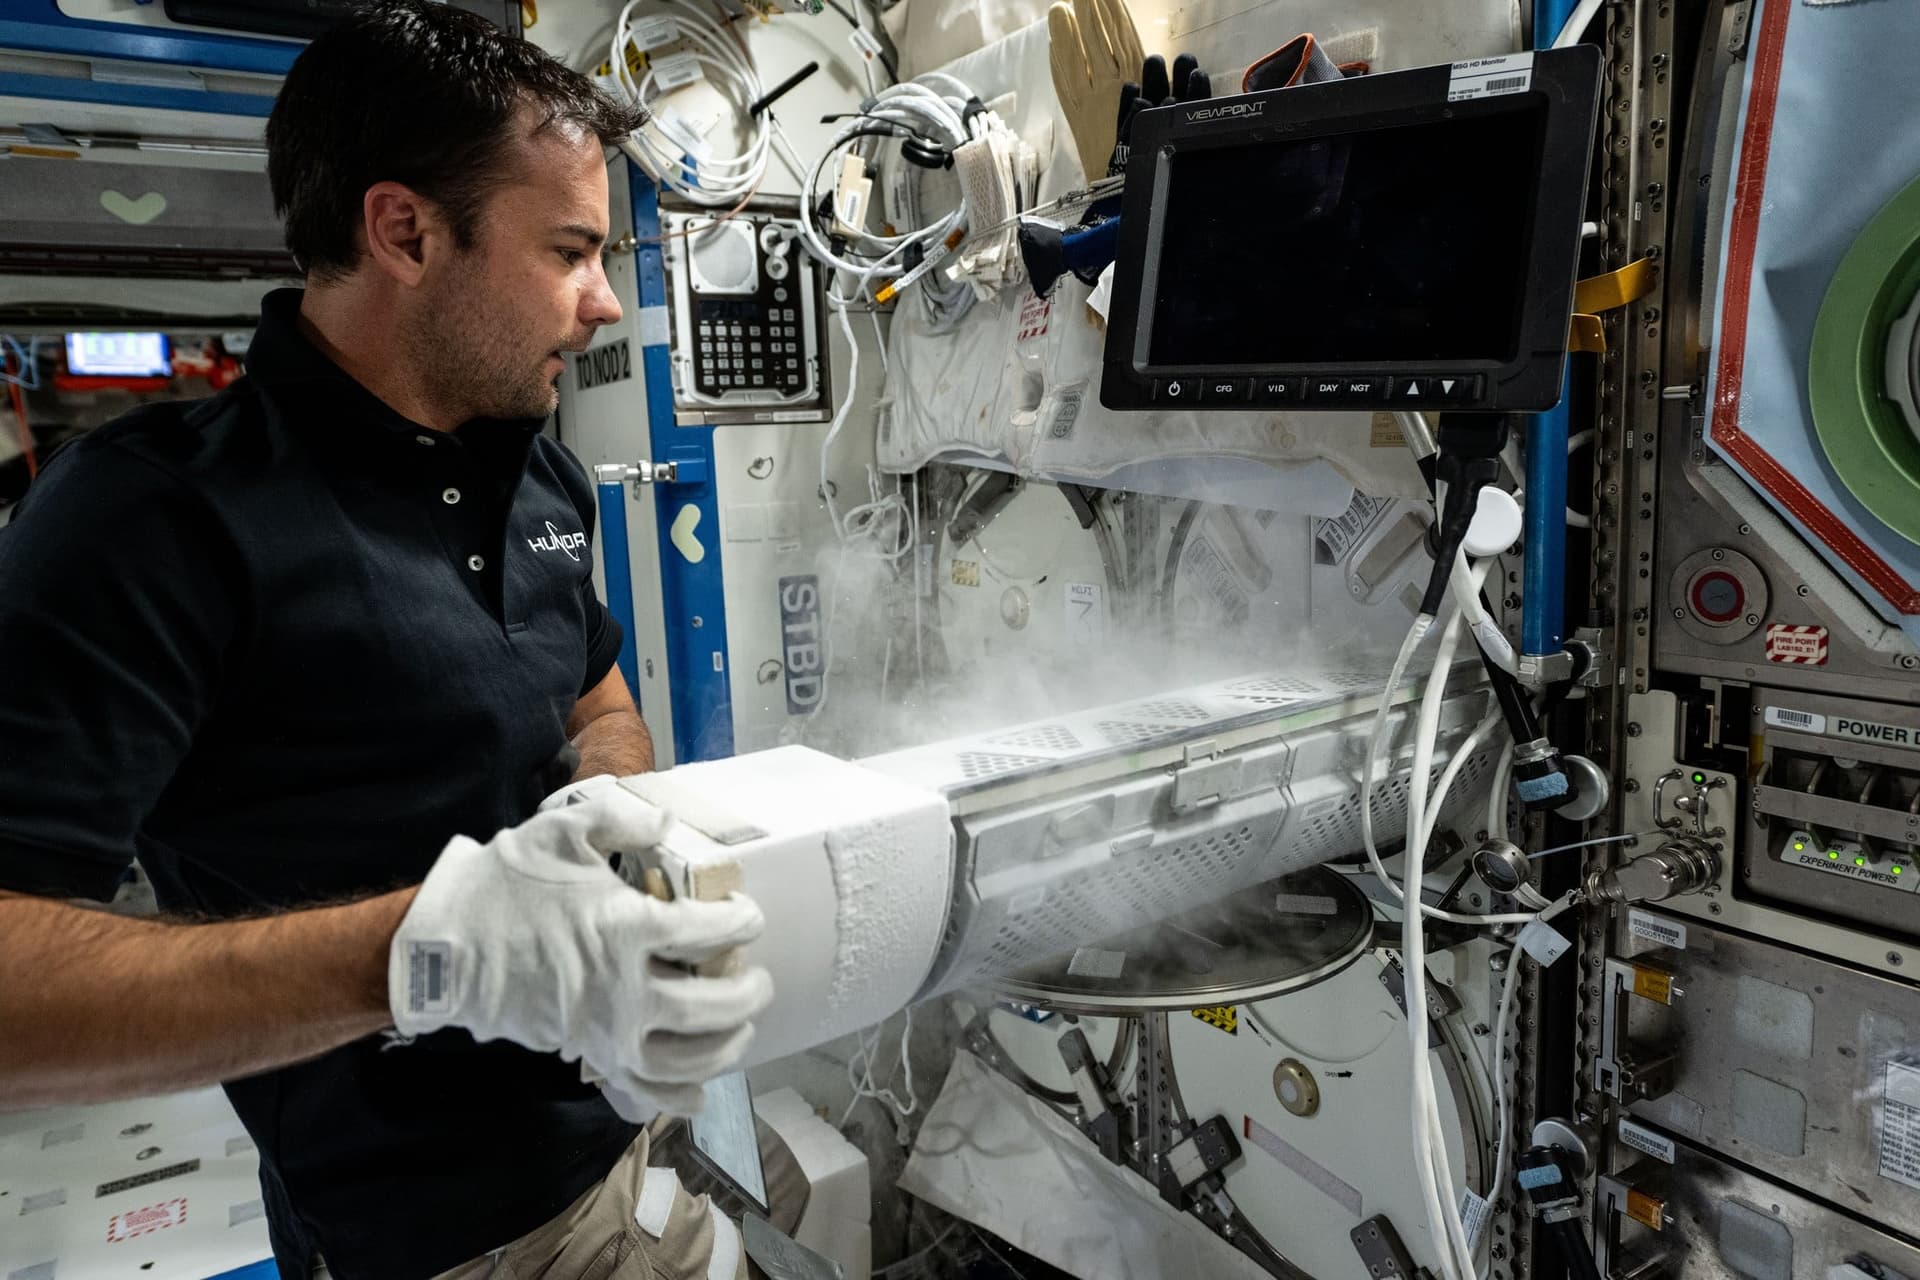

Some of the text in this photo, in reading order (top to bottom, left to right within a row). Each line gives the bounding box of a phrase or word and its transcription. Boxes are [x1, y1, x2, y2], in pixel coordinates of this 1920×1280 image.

[1453, 62, 1469, 70] MSG
[1481, 58, 1507, 67] Monitor
[1186, 100, 1267, 121] VIEWPOINT
[576, 340, 631, 390] TO NOD 2
[1215, 384, 1233, 393] CFG
[1268, 384, 1285, 393] VID
[1319, 384, 1338, 393] DAY
[1350, 384, 1371, 393] NGT
[783, 583, 822, 706] STBD
[1776, 636, 1817, 647] FIRE PORT
[1838, 719, 1908, 743] POWER
[1800, 855, 1899, 885] EXPERIMENT POWERS
